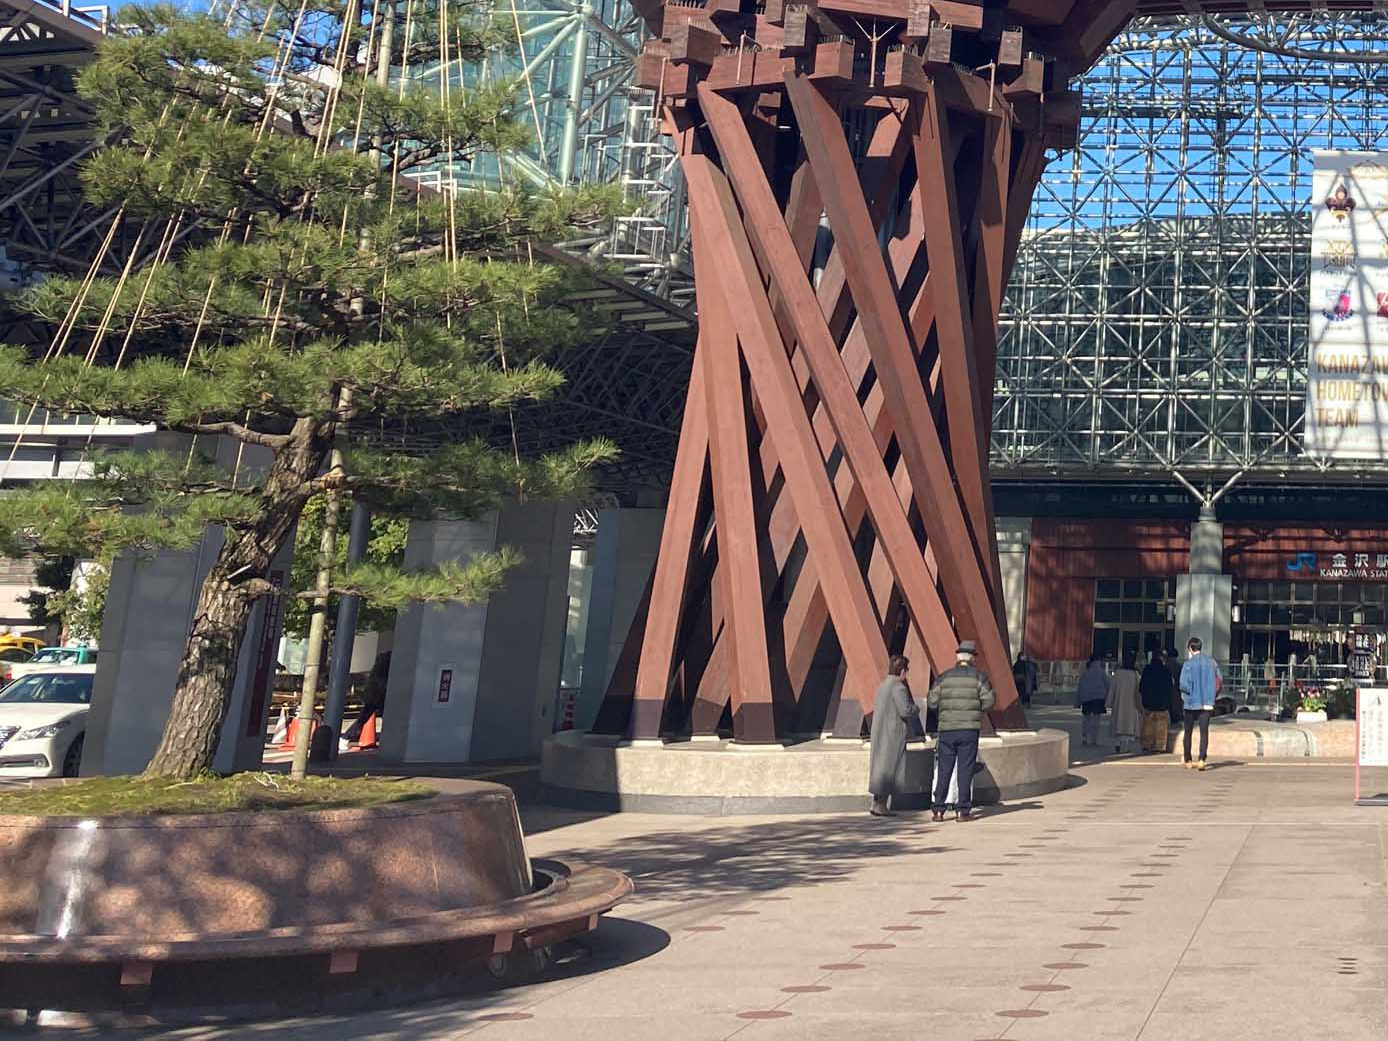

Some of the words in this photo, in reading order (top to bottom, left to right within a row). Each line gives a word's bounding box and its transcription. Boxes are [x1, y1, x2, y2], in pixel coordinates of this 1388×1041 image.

[1316, 408, 1359, 428] TEAM
[1286, 553, 1317, 571] JR
[1320, 569, 1368, 578] KANAZAWA
